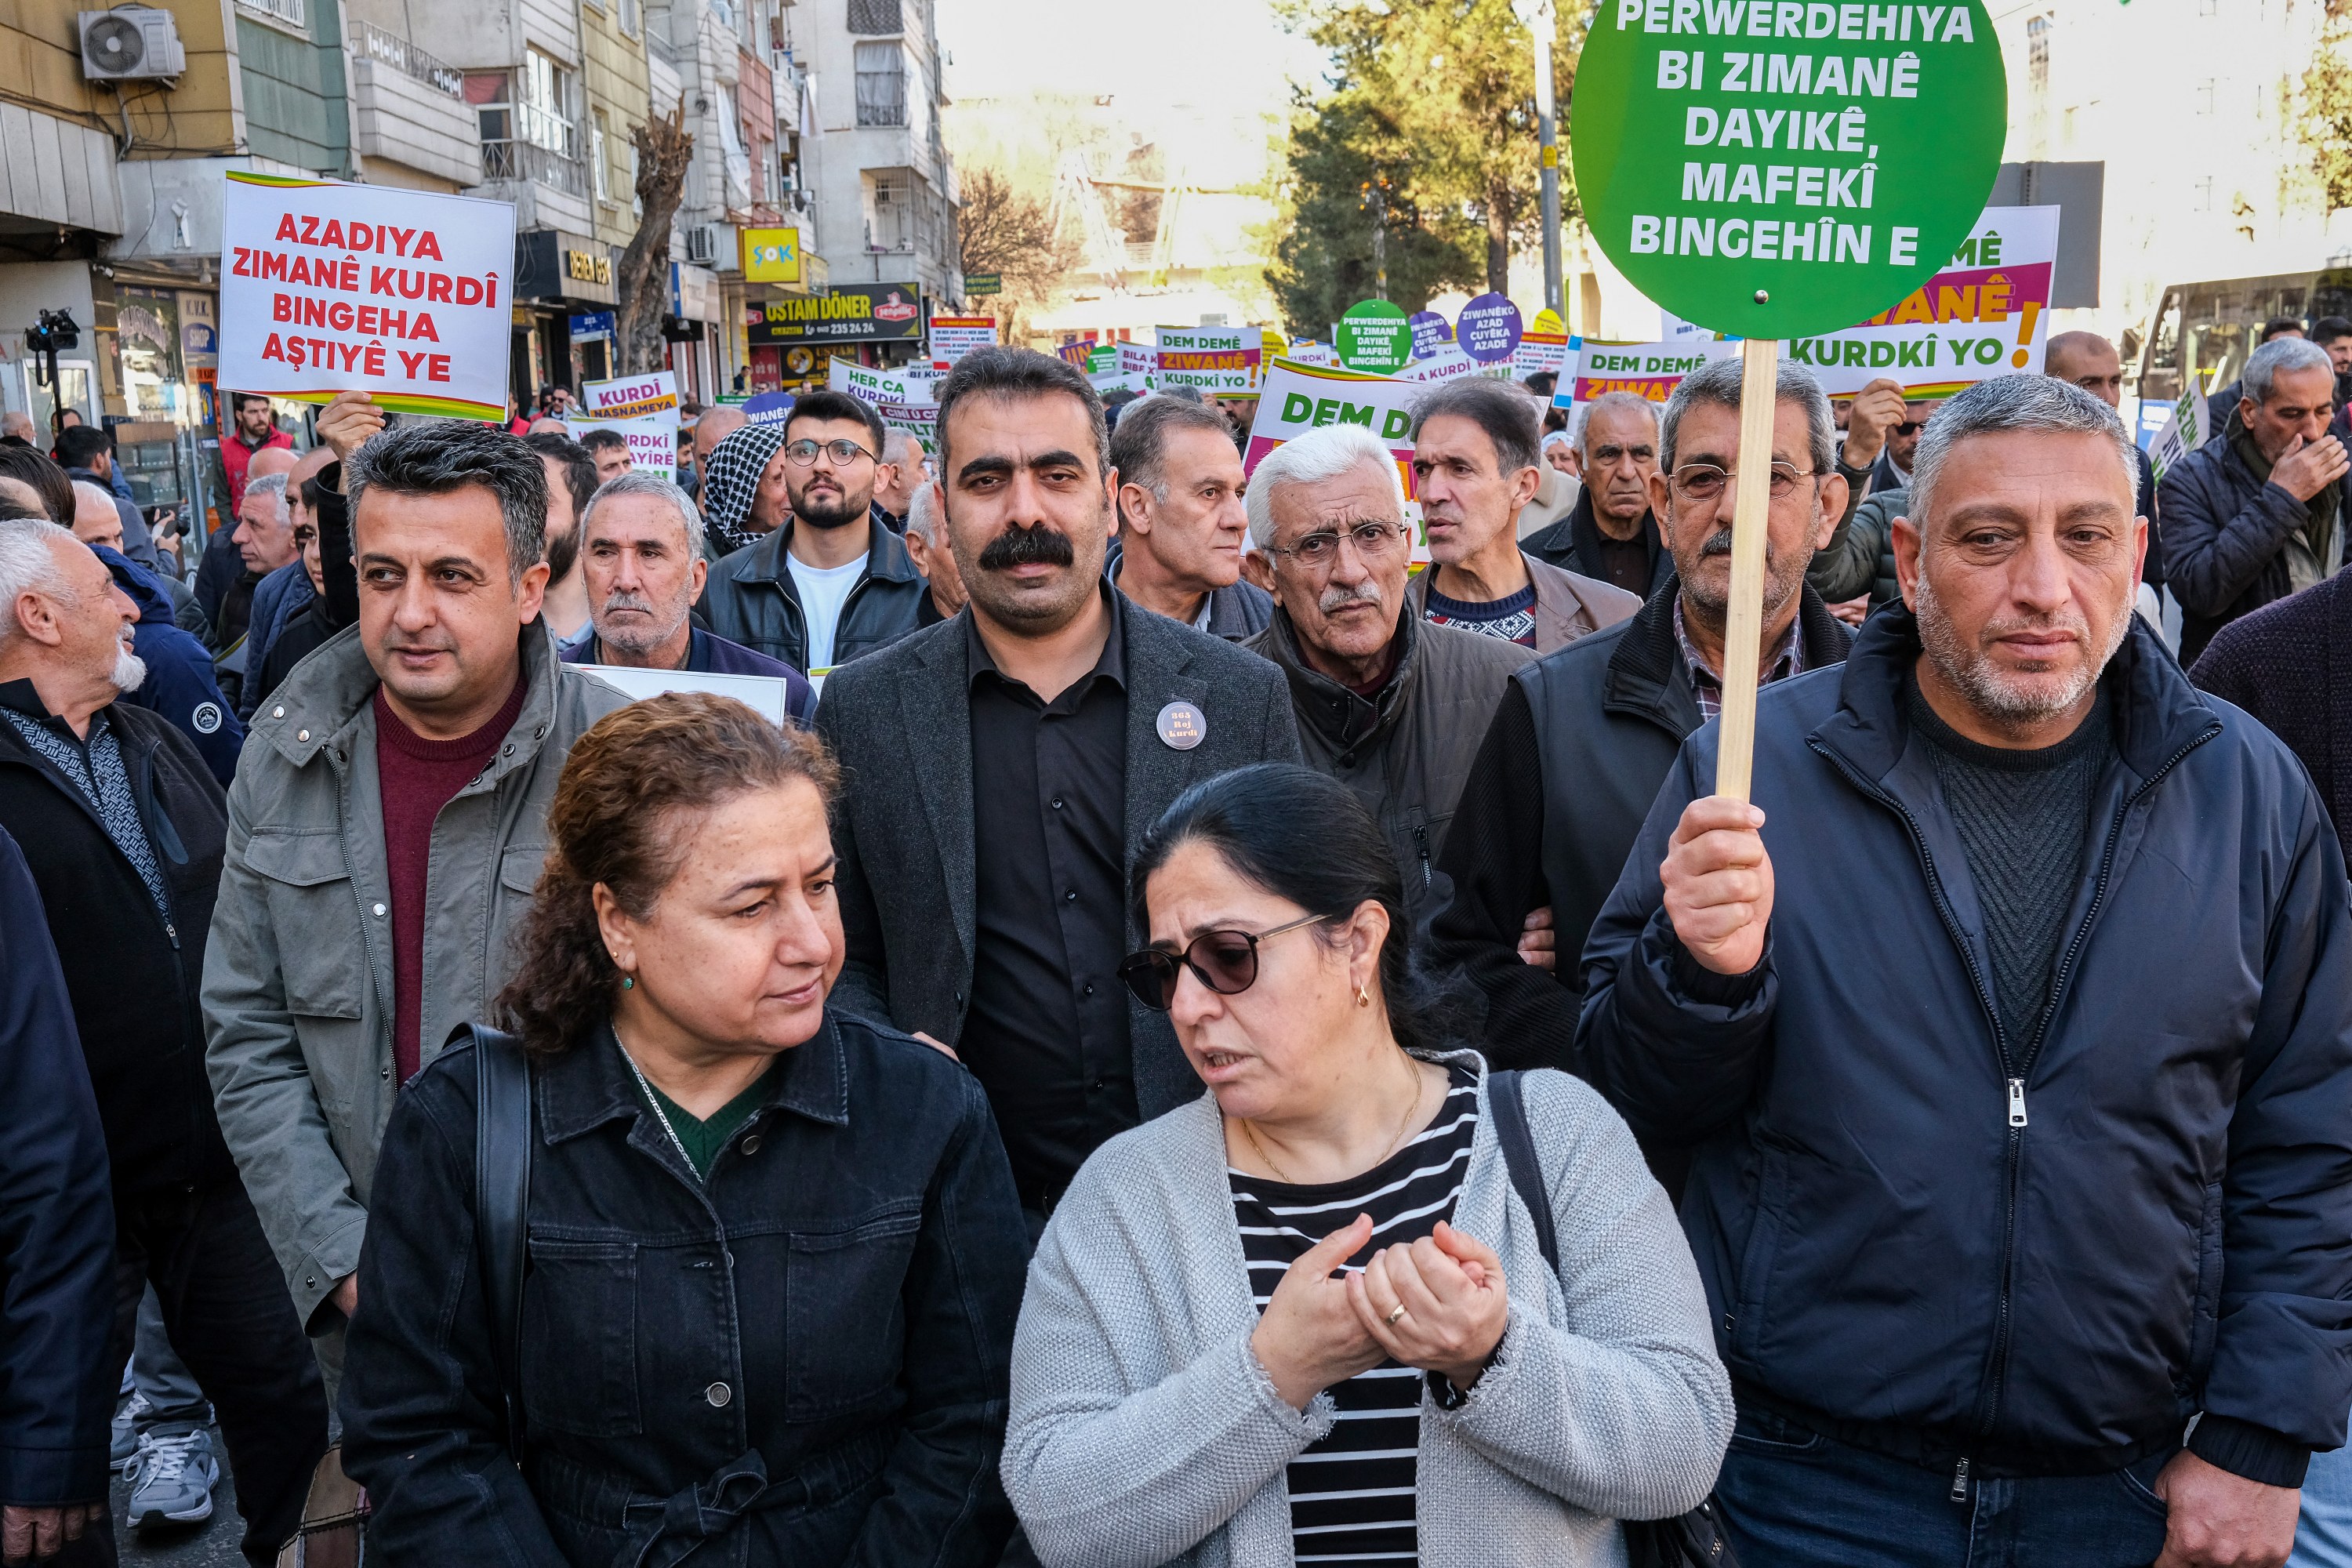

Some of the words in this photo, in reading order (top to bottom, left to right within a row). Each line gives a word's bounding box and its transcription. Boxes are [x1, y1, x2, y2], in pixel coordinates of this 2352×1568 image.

[1617, 0, 1974, 42] PERWERDEHIYA
[1657, 50, 1704, 90] BI
[1720, 52, 1920, 98] ZIMANÊ
[1684, 106, 1878, 159] DAYIKÊ,
[1681, 162, 1878, 209] MAFEKÎ
[274, 212, 443, 262] AZADIYA
[1630, 215, 1871, 264] BINGEHÎN
[1889, 227, 1918, 266] E
[753, 245, 794, 267] ŞOK
[1946, 230, 2002, 267] MÊ
[232, 246, 360, 292] ZIMANÊ
[369, 265, 499, 308] KURDÎ
[765, 298, 820, 322] USTAM
[821, 291, 872, 319] DÖNER
[1462, 306, 1515, 321] ZIWANÊKO
[273, 292, 441, 343] BINGEHA
[830, 323, 848, 334] 235
[849, 322, 862, 333] 24
[862, 322, 876, 333] 24
[1343, 318, 1406, 326] PERWERDEHIYA
[1476, 318, 1504, 329] AZAD
[189, 328, 210, 349] SHOP
[1363, 326, 1398, 336] ZIMANÊ
[1470, 328, 1511, 341] CUYÊKA
[1163, 335, 1194, 347] DEM
[1199, 336, 1241, 349] DEMÊ
[1357, 347, 1392, 356] MAFEKÎ
[1474, 339, 1508, 351] AZADE
[1790, 332, 1939, 368] KURDKÎ
[1947, 338, 2003, 366] YO
[261, 332, 387, 377] AŞTIYÊ
[397, 350, 451, 383] YE
[1163, 353, 1246, 371] ZIWANÊ
[1348, 356, 1392, 365] BINGEHÎN
[1394, 358, 1399, 366] E
[1591, 354, 1640, 372] DEM
[1646, 354, 1707, 373] DEMÊ
[1429, 358, 1471, 379] KURDÎ
[849, 370, 878, 389] HER
[882, 380, 906, 394] CA
[1165, 372, 1219, 387] KURDKÎ
[1223, 376, 1245, 387] YO
[598, 378, 662, 407] KURDÎ
[1585, 379, 1677, 402] ZIWA
[593, 401, 673, 418] NASNAMEYA
[749, 407, 793, 423] WANÊK
[623, 434, 669, 448] RDKÎ
[630, 450, 674, 465] AYÎRÊ
